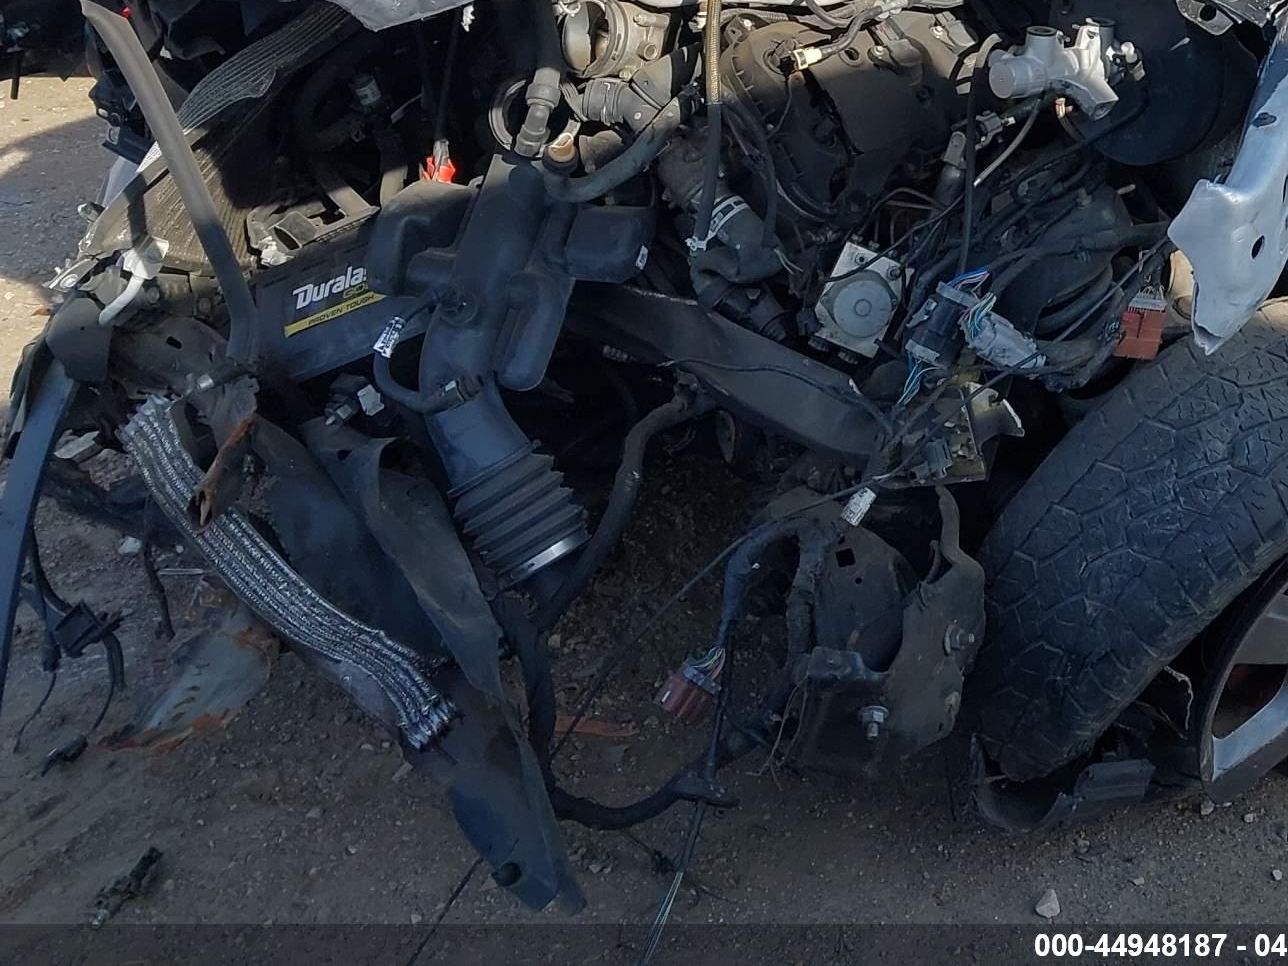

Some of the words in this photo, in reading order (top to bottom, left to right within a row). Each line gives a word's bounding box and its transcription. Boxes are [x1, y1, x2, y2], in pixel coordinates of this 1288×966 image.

[292, 265, 367, 310] Durala
[342, 283, 368, 299] GO
[308, 306, 343, 326] PROVEN
[345, 294, 376, 311] TOUGH
